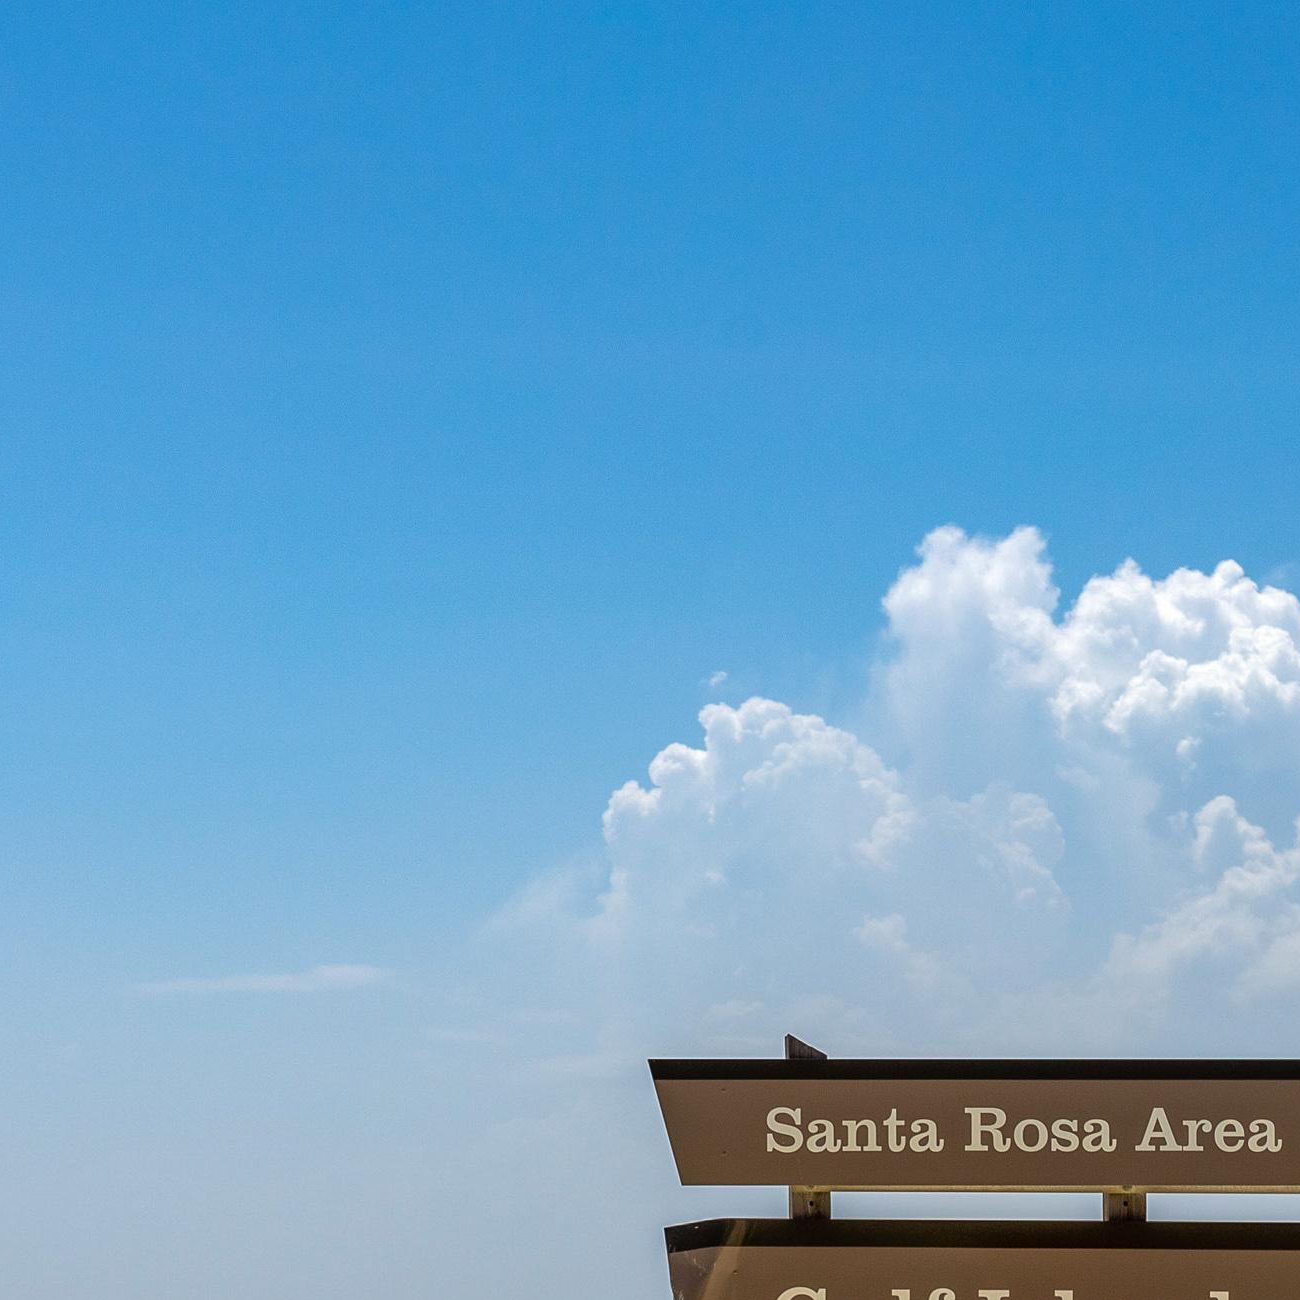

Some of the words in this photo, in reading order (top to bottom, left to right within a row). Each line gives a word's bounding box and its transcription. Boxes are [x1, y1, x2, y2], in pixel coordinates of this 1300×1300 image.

[766, 1107, 944, 1153] Santa
[964, 1107, 1117, 1153] Rosa
[1135, 1107, 1283, 1153] Area
